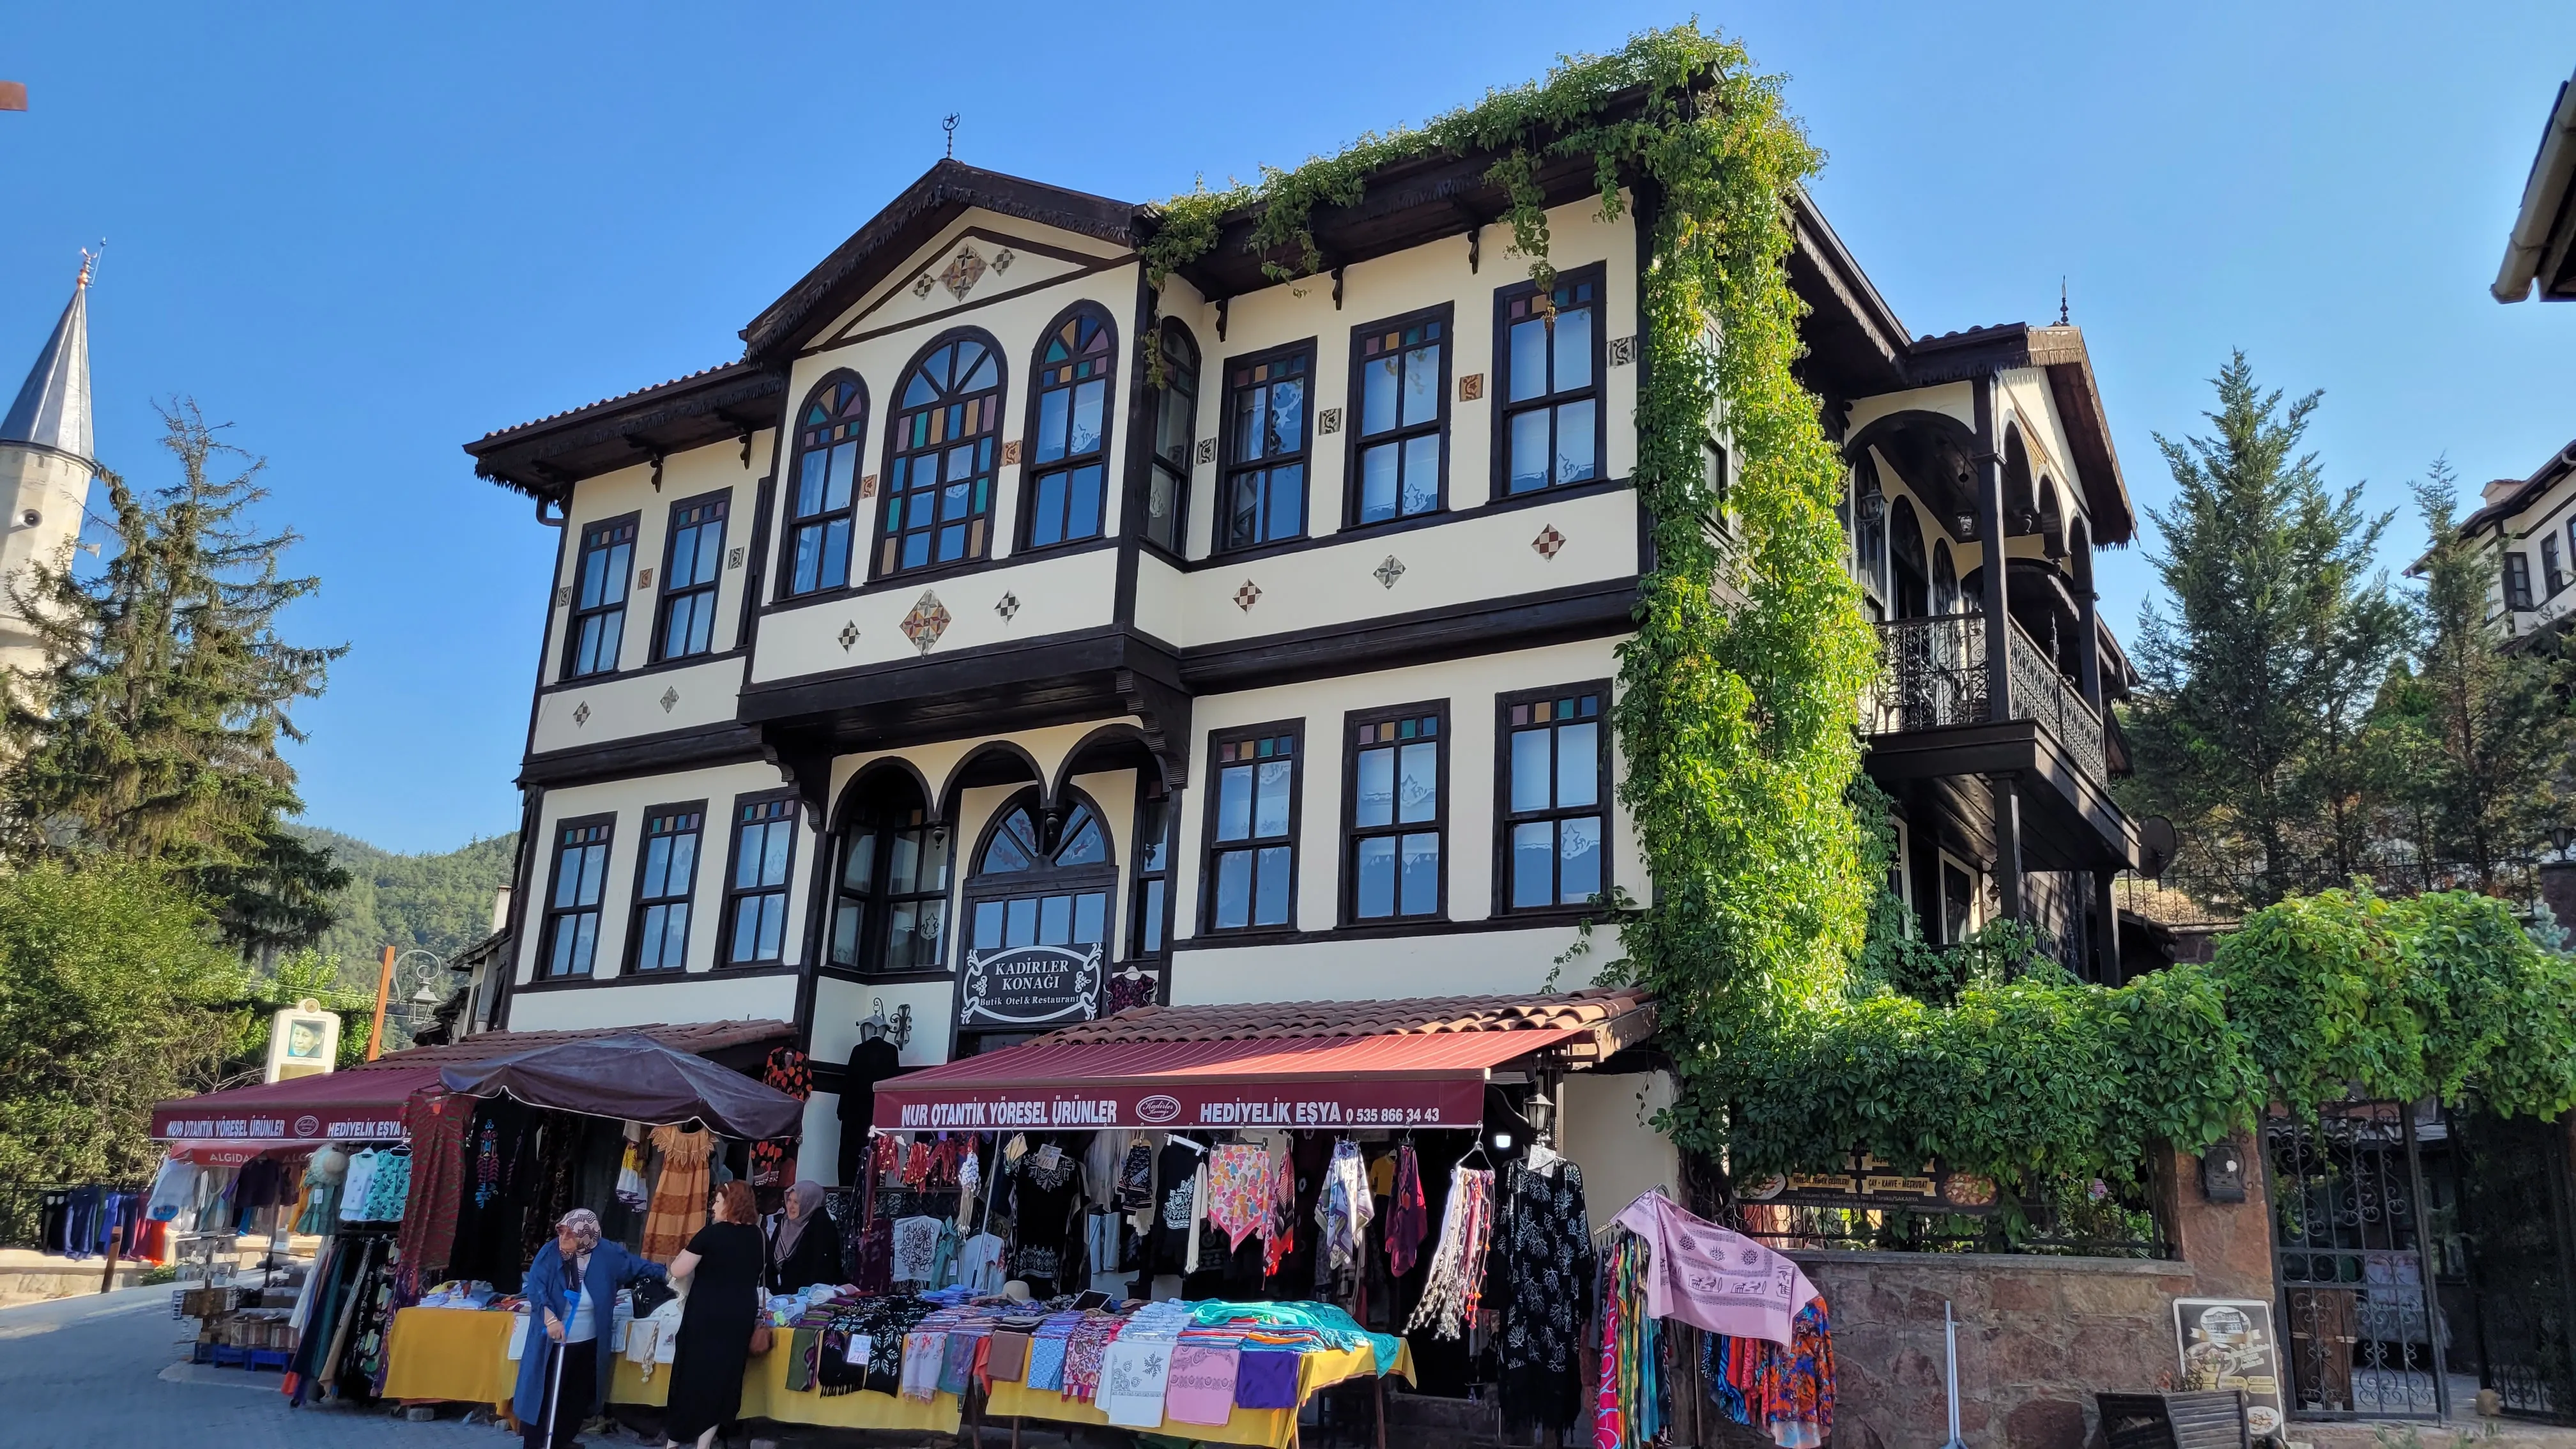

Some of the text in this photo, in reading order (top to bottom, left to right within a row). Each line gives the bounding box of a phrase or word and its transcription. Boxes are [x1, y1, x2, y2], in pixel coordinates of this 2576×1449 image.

[995, 957, 1070, 976] KADİRLER
[1002, 974, 1060, 990] KONAĞI
[980, 995, 1080, 1006] Butik Otel & Restaurant
[901, 1094, 1117, 1126] NUR OTANTİK YÖRESEL ÜRÜNLER
[1200, 1097, 1439, 1125] HEDİYELİK EŞYA 0 535 866 34 43
[184, 1116, 214, 1137] OTANTİK
[215, 1116, 248, 1137] YÖRESEL
[250, 1115, 286, 1137] ÜRÜNLER
[327, 1117, 376, 1137] HEDİYELİK
[376, 1121, 401, 1138] EŞYA
[1882, 1179, 1897, 1188] KAHVE
